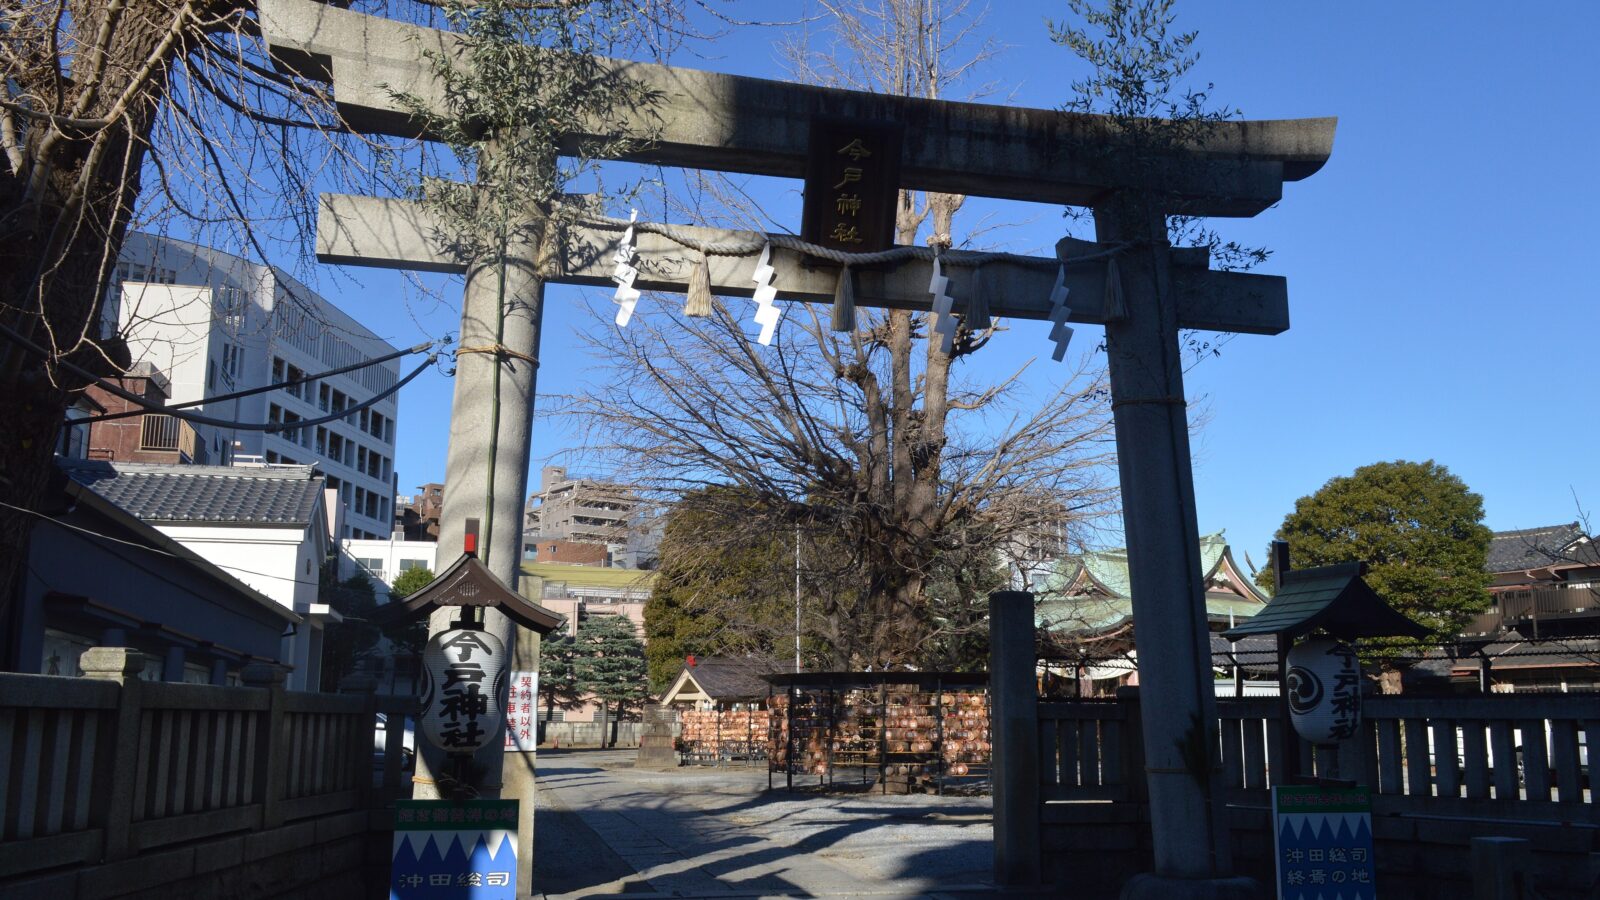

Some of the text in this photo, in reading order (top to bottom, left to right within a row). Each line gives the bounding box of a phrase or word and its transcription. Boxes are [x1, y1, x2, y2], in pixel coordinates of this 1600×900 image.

[830, 138, 873, 244] 今戸神社
[440, 631, 492, 748] 今戸神社
[520, 676, 532, 740] 契約者以外
[1325, 641, 1361, 741] 今戸神社
[398, 871, 511, 888] 沖田総司
[1286, 847, 1368, 863] 沖田総司
[1287, 867, 1371, 886] 終焉の地
